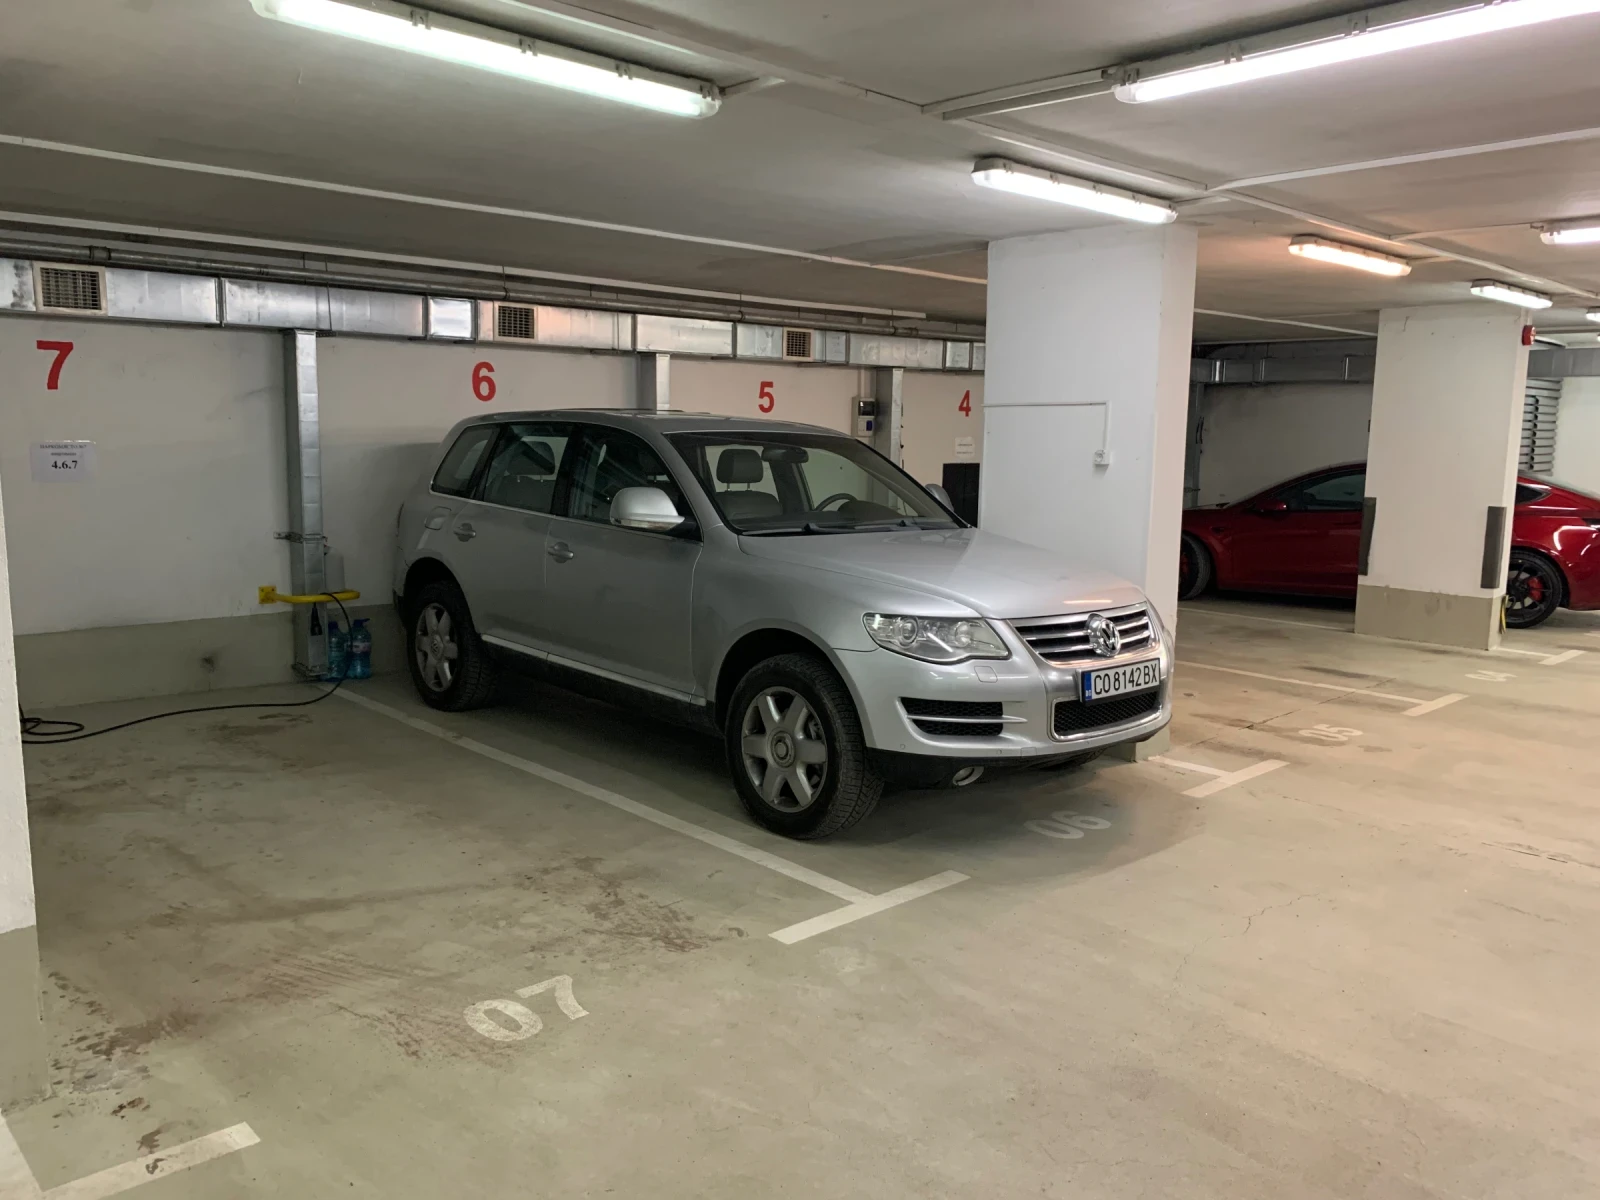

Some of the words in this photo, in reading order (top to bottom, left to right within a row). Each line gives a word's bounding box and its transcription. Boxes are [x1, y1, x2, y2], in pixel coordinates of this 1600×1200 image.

[37, 341, 74, 390] 7
[471, 361, 497, 402] 6
[758, 381, 775, 414] 5
[958, 389, 971, 417] 4
[51, 460, 78, 469] 4.6.7
[1094, 673, 1111, 695] CO
[1113, 667, 1141, 691] 8142
[1143, 663, 1158, 685] BX
[1298, 723, 1364, 741] 05
[1023, 810, 1112, 839] 06
[463, 974, 590, 1041] 07
